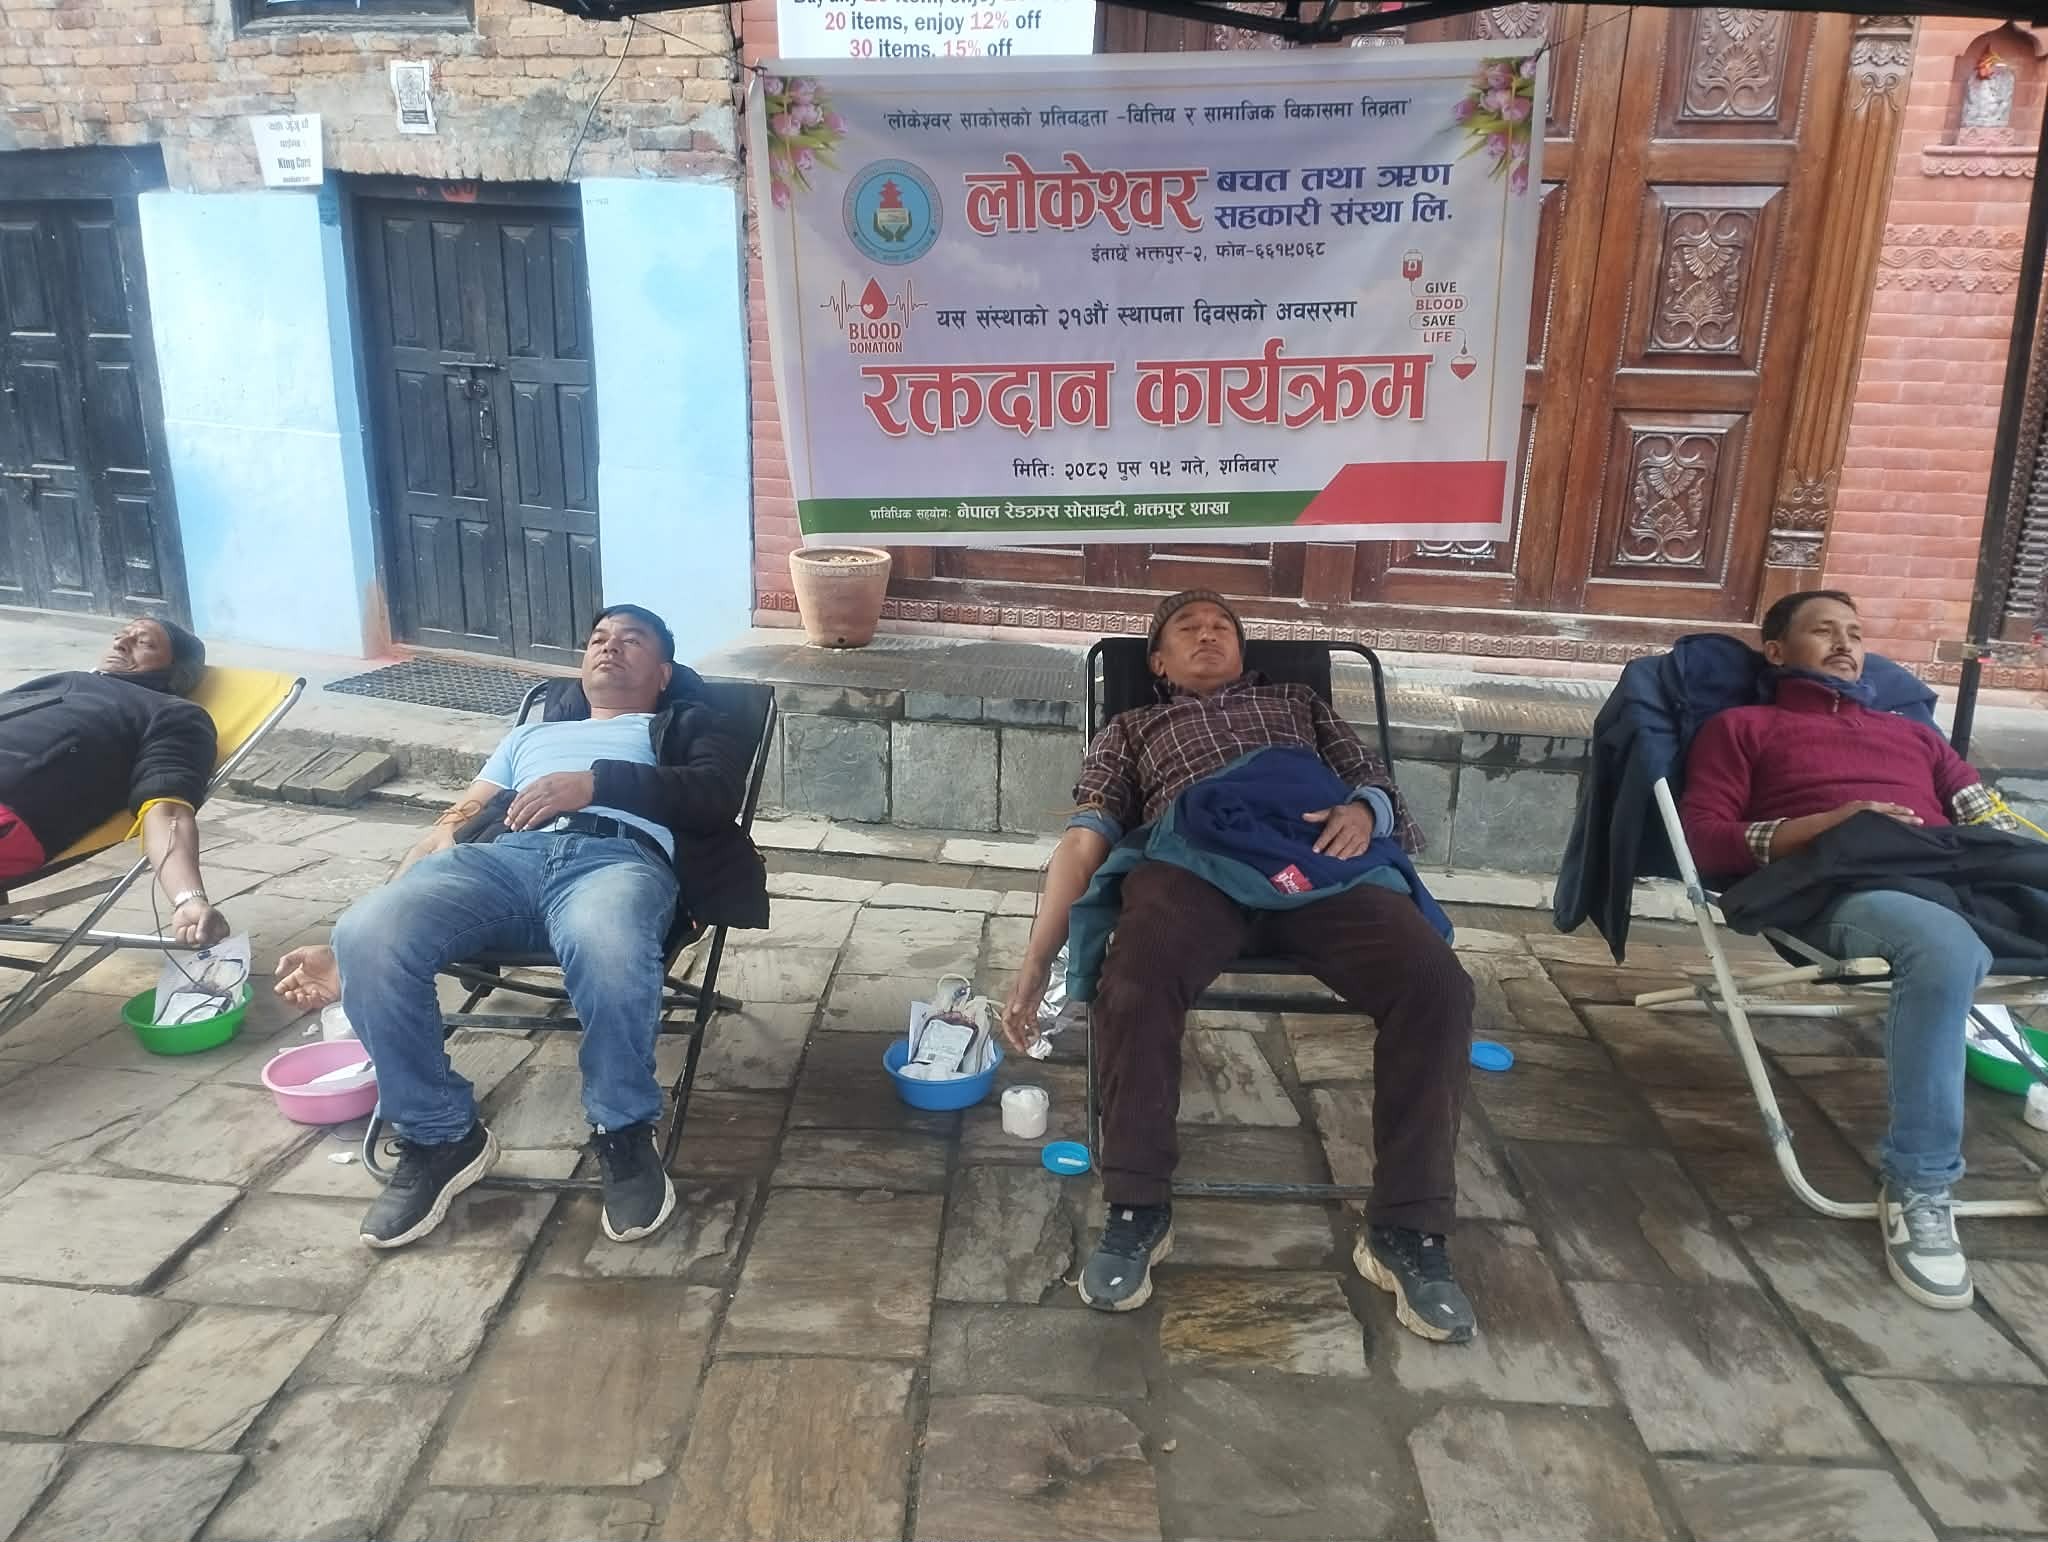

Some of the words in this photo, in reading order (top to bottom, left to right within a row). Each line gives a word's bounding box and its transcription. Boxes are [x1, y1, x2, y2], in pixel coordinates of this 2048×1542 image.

[825, 12, 846, 30] 20
[851, 11, 908, 34] items,
[915, 13, 964, 35] enjoy
[970, 11, 1009, 30] 12%
[1015, 9, 1042, 29] off
[850, 39, 873, 57] 30
[943, 39, 981, 57] 15%
[987, 38, 1013, 57] off
[1184, 107, 1197, 126] र
[1204, 99, 1276, 124] सामाजिक
[1285, 98, 1353, 120] विकासमा
[1217, 168, 1291, 193] बचत
[1301, 166, 1367, 191] तथा
[1377, 164, 1454, 188] ऋण
[964, 152, 1209, 236] लोकेश्वर
[1215, 196, 1322, 230] सहकारी
[1331, 197, 1404, 226] संस्था
[1411, 192, 1453, 223] लि.
[1425, 282, 1457, 294] GIVE
[936, 310, 966, 329] यस
[976, 304, 1048, 328] संस्थाको
[1117, 305, 1185, 326] स्थापना
[1194, 298, 1266, 325] दिवसको
[1276, 301, 1358, 322] अवसरमा
[1416, 298, 1464, 311] BLOOD
[849, 322, 901, 340] BLOOD
[1422, 314, 1456, 327] SAVE
[850, 341, 903, 353] DONATION
[1423, 331, 1453, 343] LIFE
[860, 360, 1117, 438] रक्तदान
[1134, 336, 1436, 429] कार्यक्रम
[1065, 462, 1109, 480] २०८२
[1117, 461, 1142, 480] पुस
[1180, 456, 1209, 478] गते,
[957, 502, 1000, 519] नेपाल
[1004, 501, 1060, 519] रेडक्रस
[1133, 502, 1187, 519] भक्तपुर
[1190, 501, 1231, 516] शाखा
